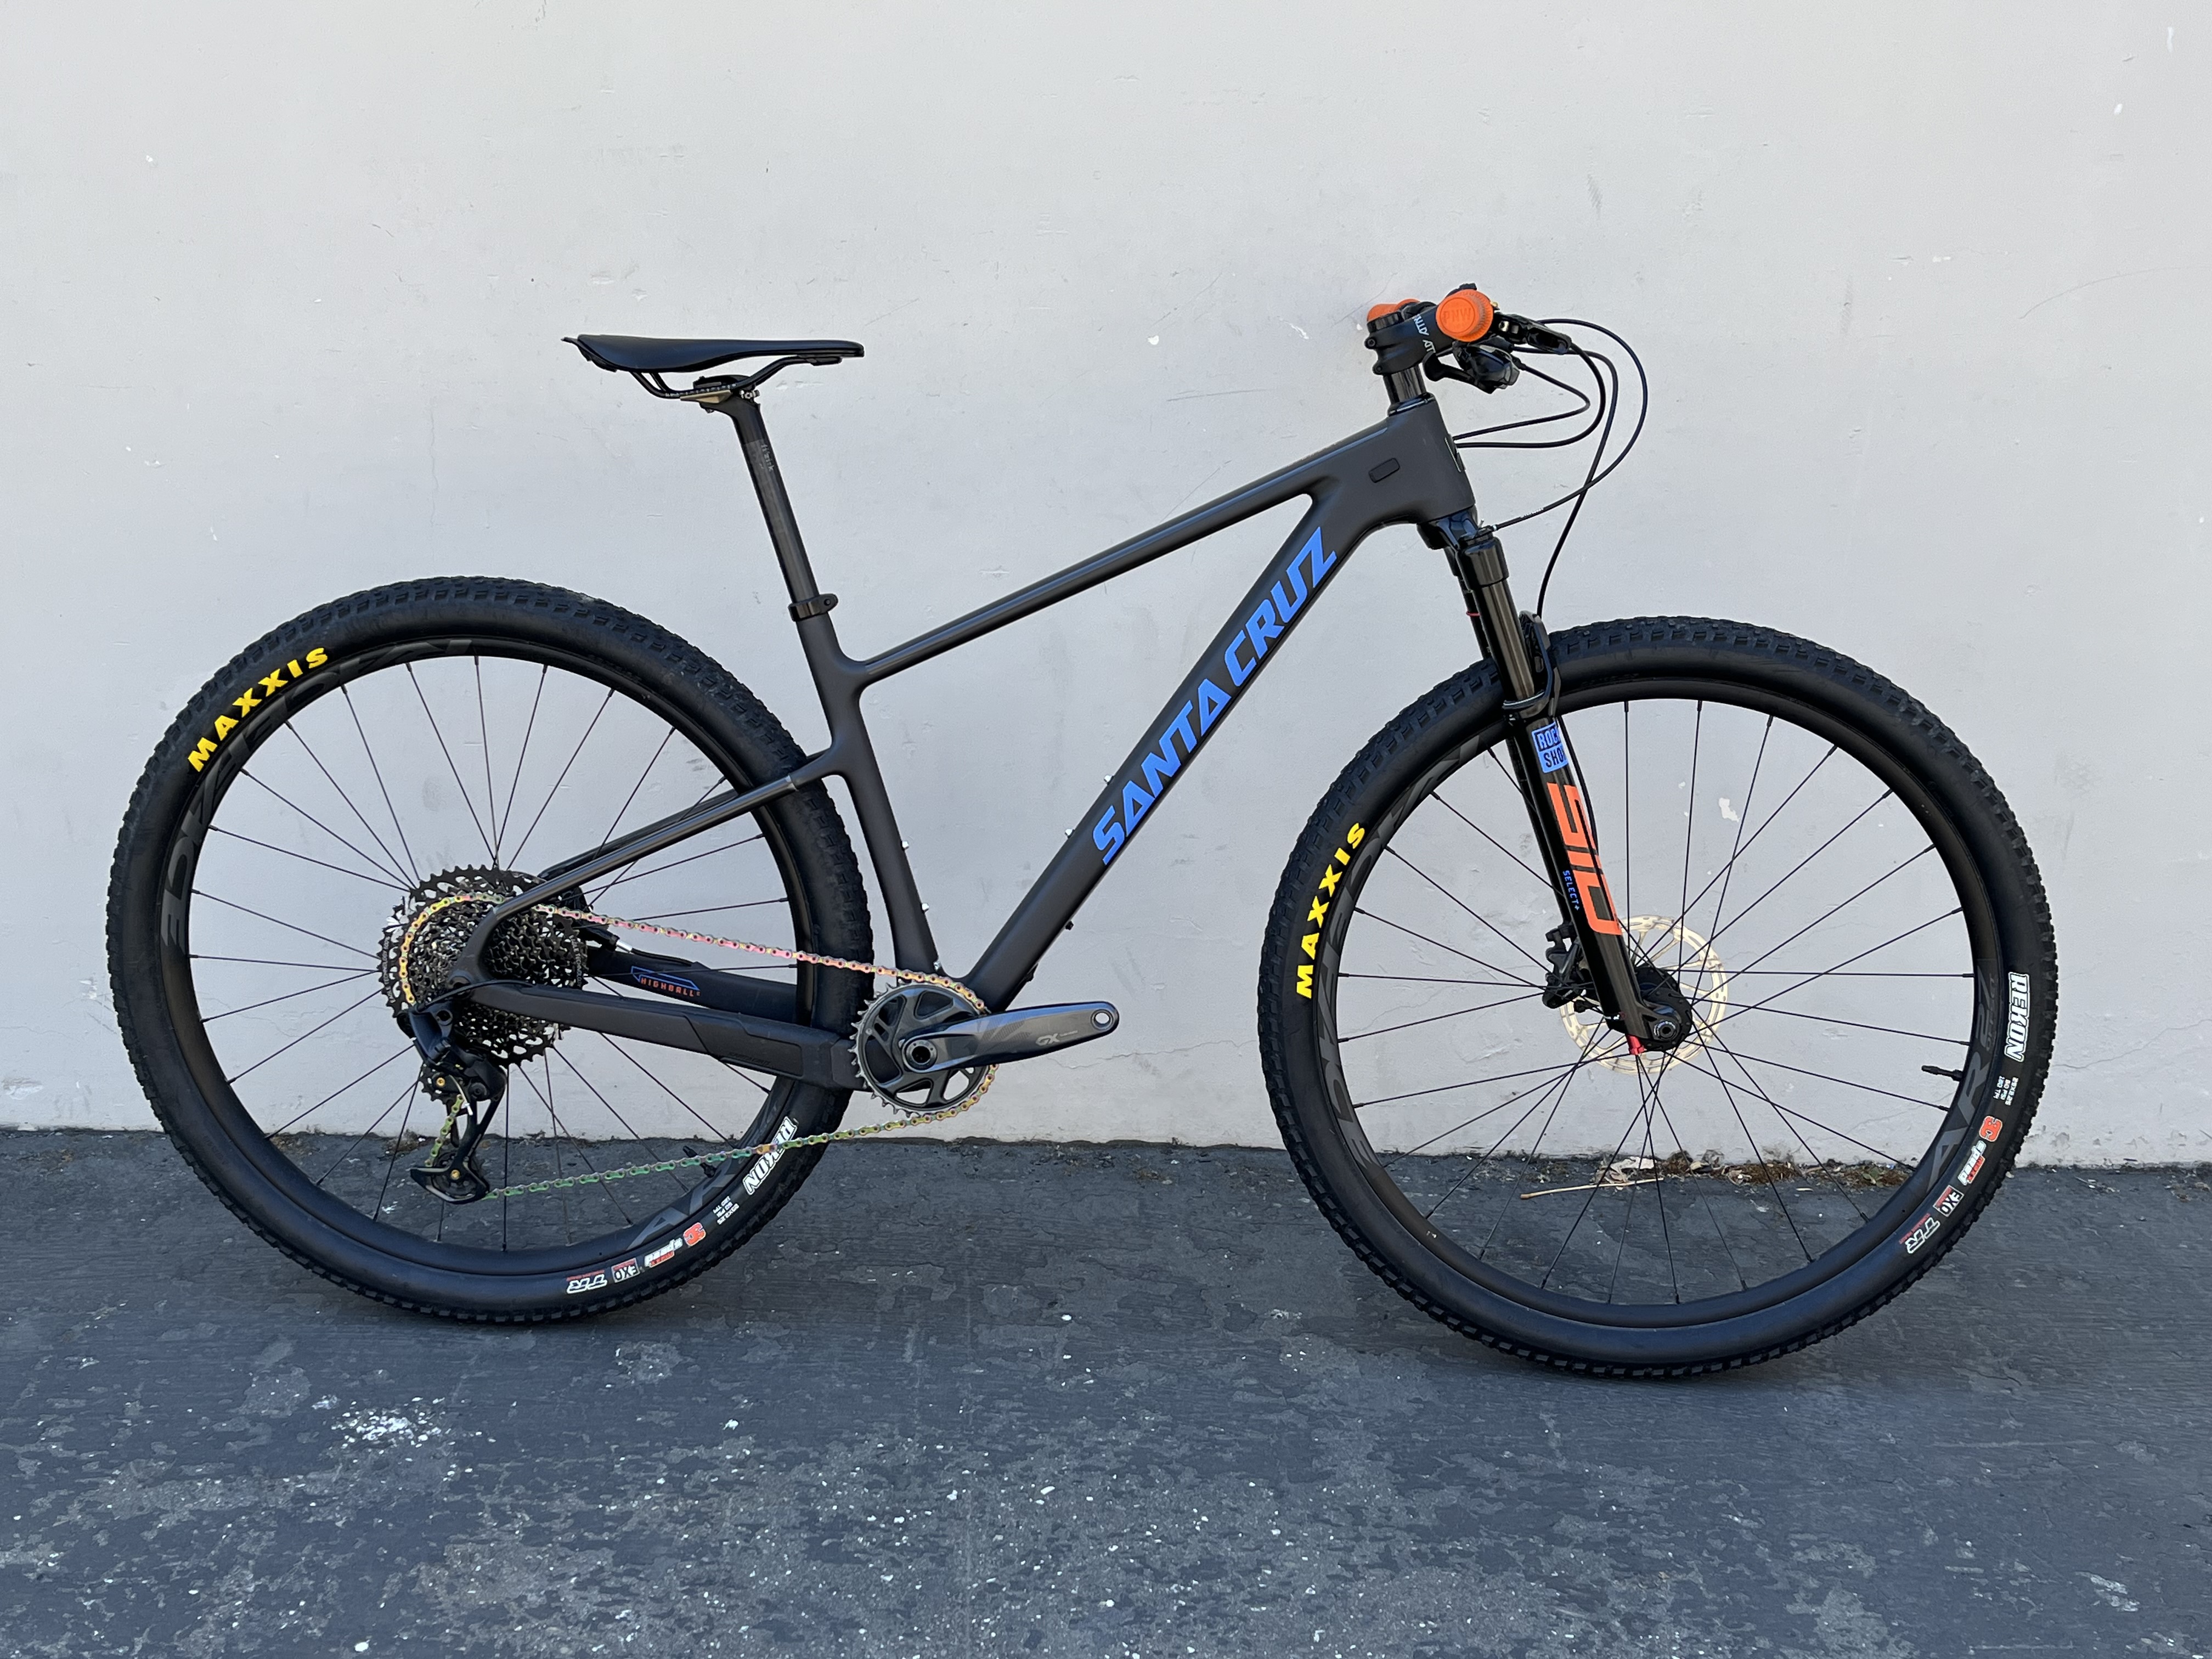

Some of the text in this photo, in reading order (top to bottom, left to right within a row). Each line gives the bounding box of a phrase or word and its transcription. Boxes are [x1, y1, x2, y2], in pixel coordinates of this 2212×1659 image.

[1093, 527, 1337, 865] SANTA CRUZ
[188, 648, 328, 772] MAXXIS
[1537, 725, 1561, 749] ROC
[1543, 747, 1565, 768] SHO
[1297, 823, 1364, 998] MAXXIS
[641, 977, 694, 997] HIGHBALL
[2005, 973, 2030, 1062] REKON
[1035, 1033, 1060, 1046] GX
[1939, 1190, 1962, 1216] EXO
[1905, 1217, 1940, 1254] TR
[613, 1265, 637, 1282] EXO
